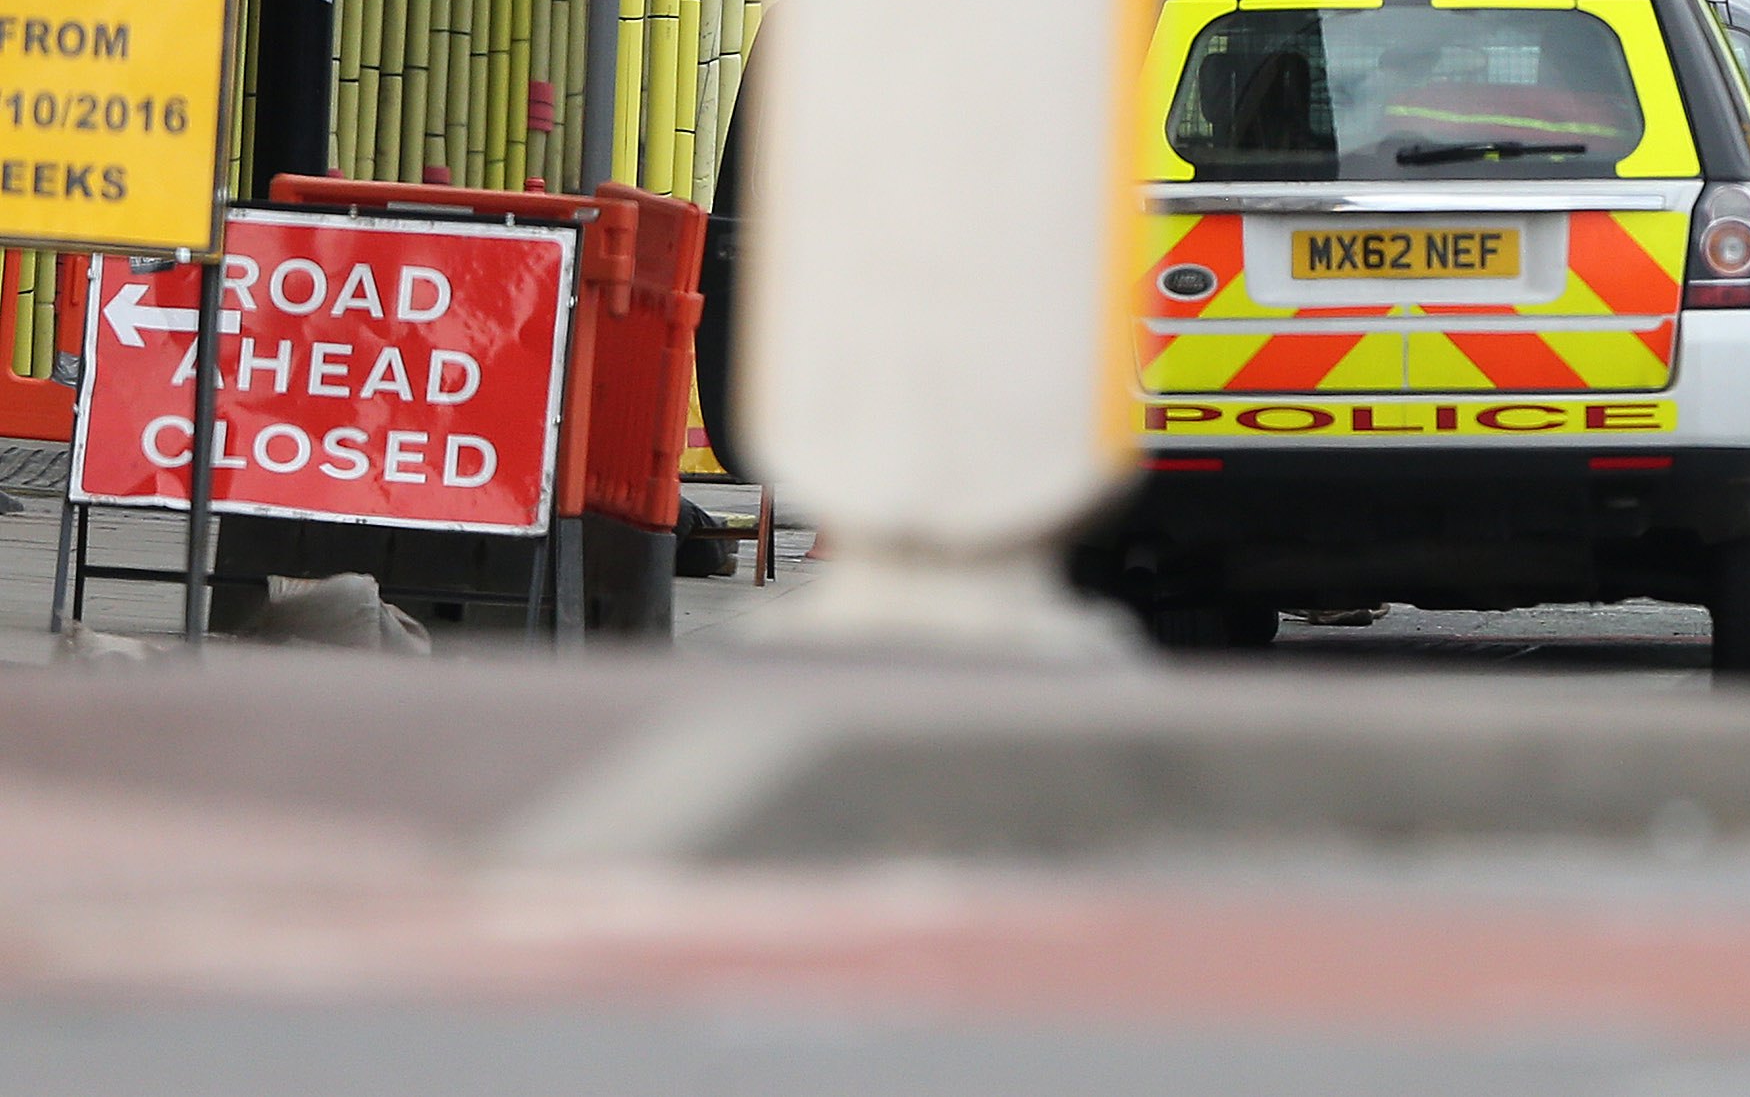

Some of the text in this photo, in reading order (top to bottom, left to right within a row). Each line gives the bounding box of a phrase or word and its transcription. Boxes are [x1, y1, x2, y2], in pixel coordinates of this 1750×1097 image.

[0, 16, 129, 59] FROM
[0, 90, 189, 133] 10/2016
[1308, 232, 1503, 271] MX62 NEF
[220, 254, 451, 323] ROAD
[171, 337, 482, 405] AHEAD
[1143, 404, 1663, 432] POLICE
[140, 414, 499, 488] CLOSED
